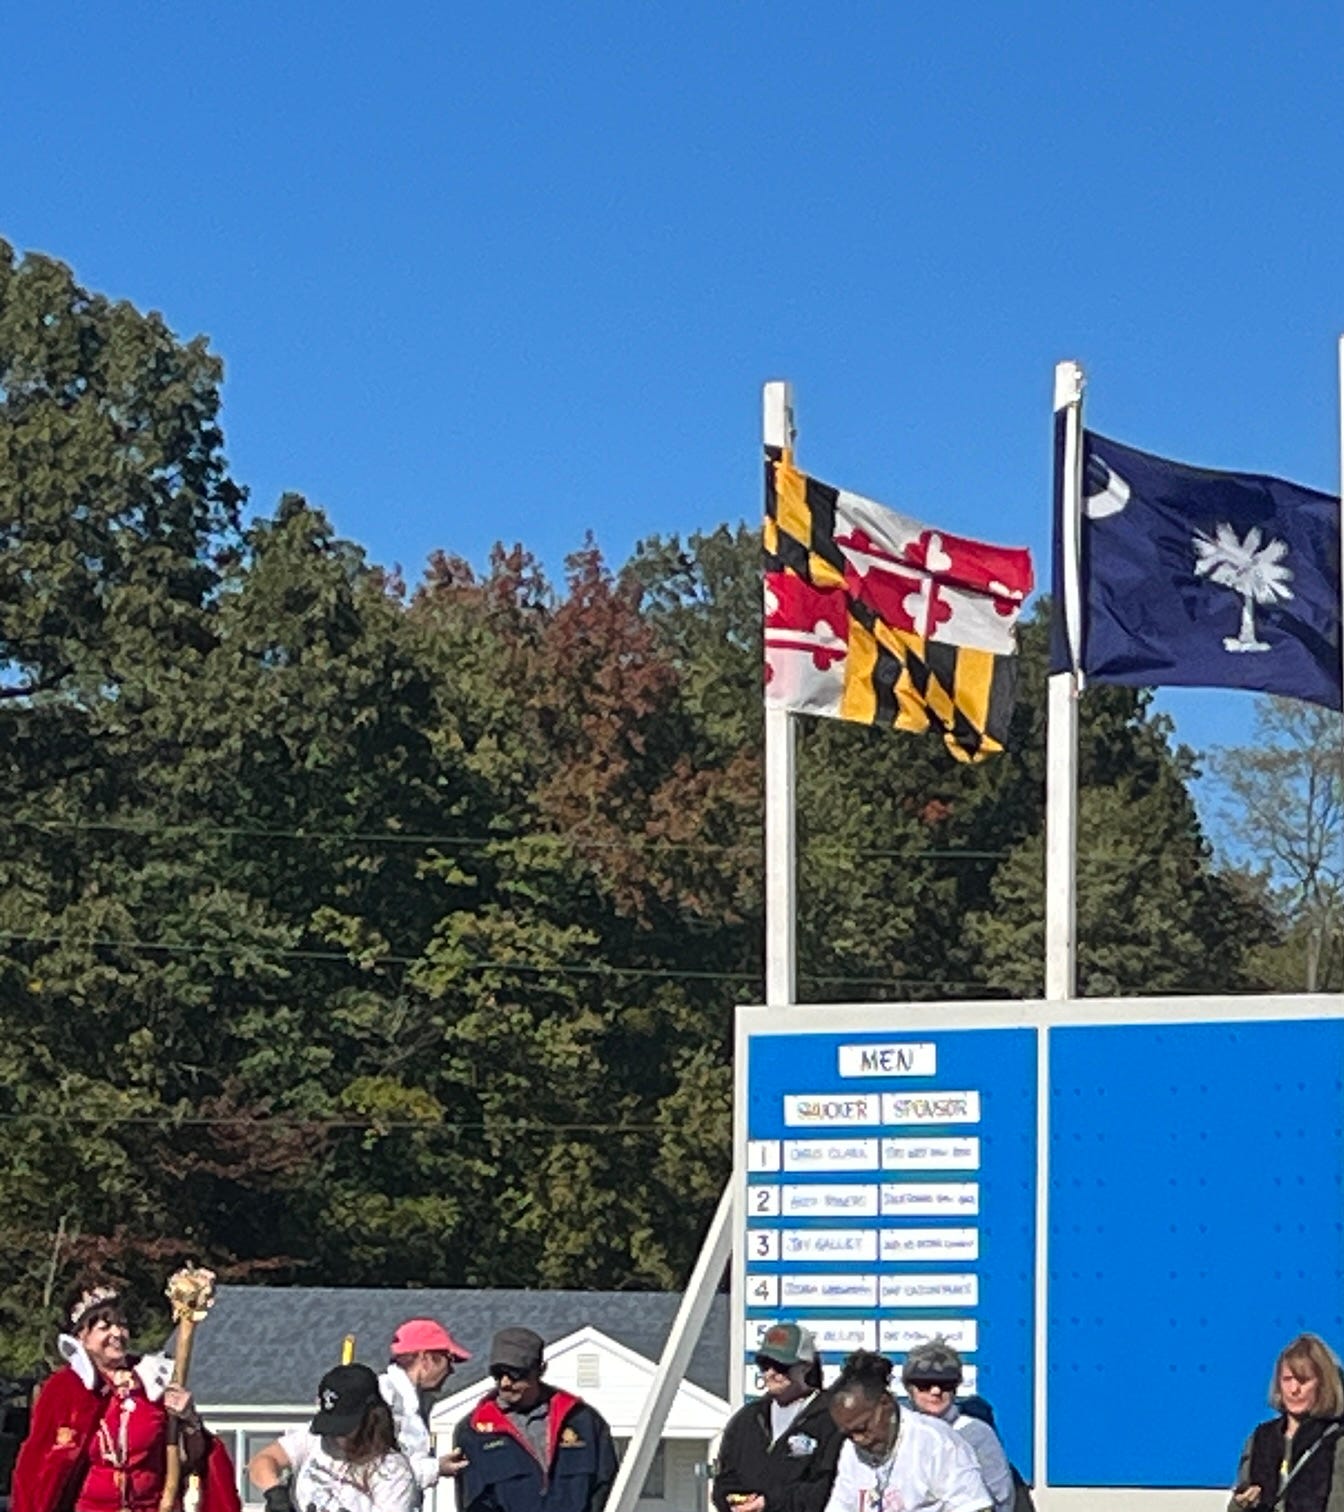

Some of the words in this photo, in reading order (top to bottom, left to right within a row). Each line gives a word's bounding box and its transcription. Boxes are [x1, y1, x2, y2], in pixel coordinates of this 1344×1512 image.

[860, 1049, 914, 1073] MEN
[892, 1097, 968, 1118] SPONSOR
[756, 1190, 771, 1213] 2
[756, 1235, 770, 1257] 3
[754, 1280, 770, 1301] 4
